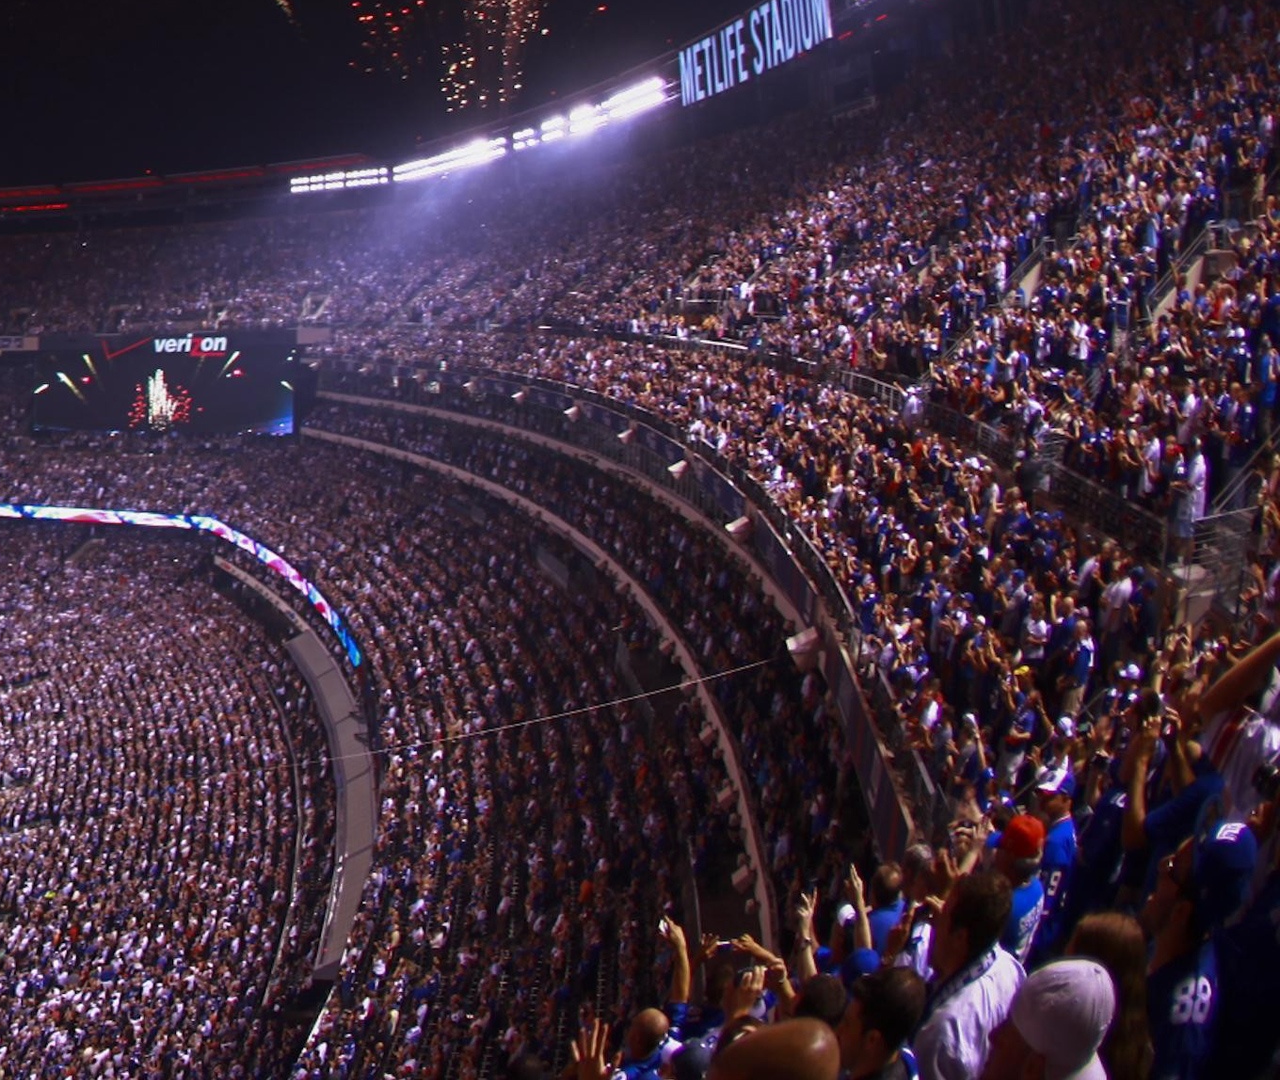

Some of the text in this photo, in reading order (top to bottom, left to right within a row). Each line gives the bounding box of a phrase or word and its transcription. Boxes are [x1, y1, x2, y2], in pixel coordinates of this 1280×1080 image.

[678, 18, 749, 106] METLIFE
[154, 332, 228, 356] verizon
[1170, 975, 1212, 1024] 88
